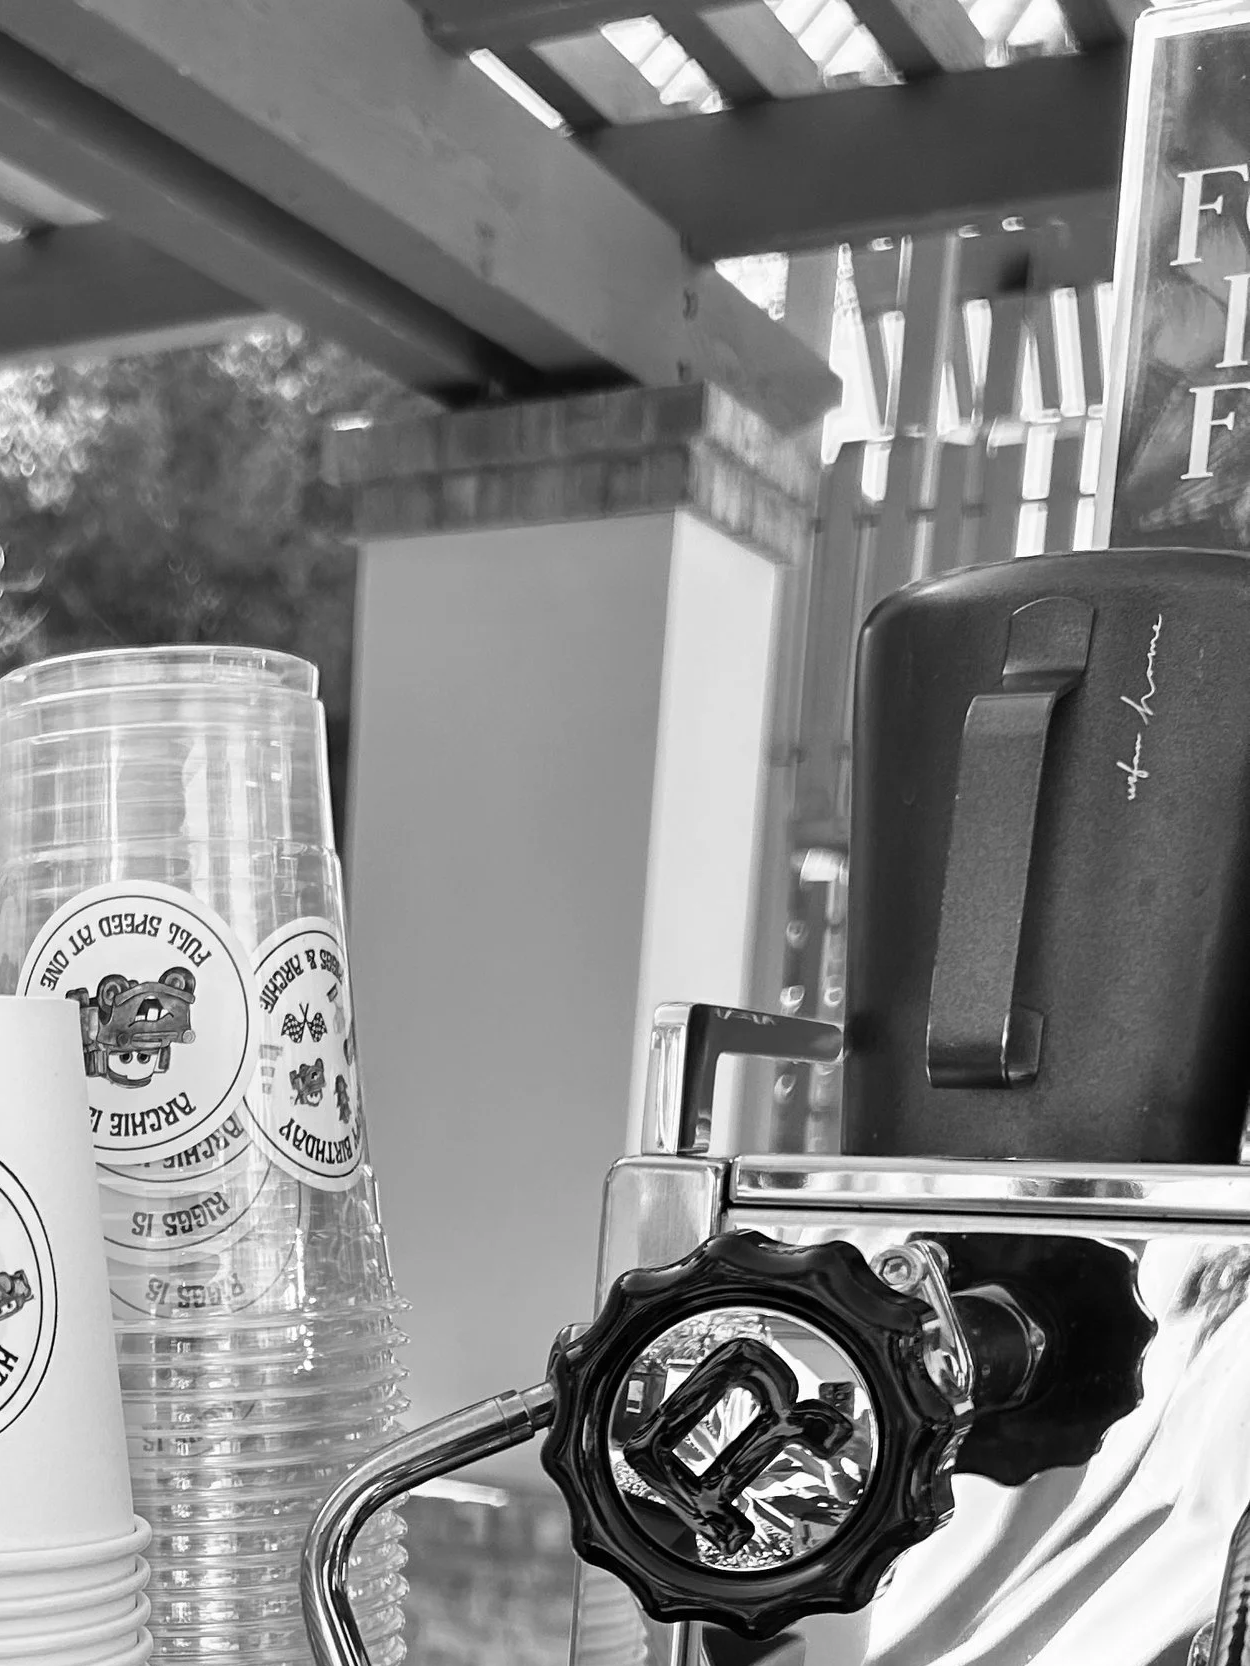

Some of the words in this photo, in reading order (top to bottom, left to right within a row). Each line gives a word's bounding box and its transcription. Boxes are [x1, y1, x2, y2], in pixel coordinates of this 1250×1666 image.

[99, 912, 161, 938] SPEED
[69, 927, 97, 956] AT
[167, 923, 212, 969] FULL
[40, 953, 70, 992] ONE
[304, 949, 315, 970] &
[110, 1092, 197, 1137] ARCHIE
[132, 1211, 154, 1237] IS
[164, 1191, 232, 1237] RIGGS
[145, 1277, 168, 1304] IS
